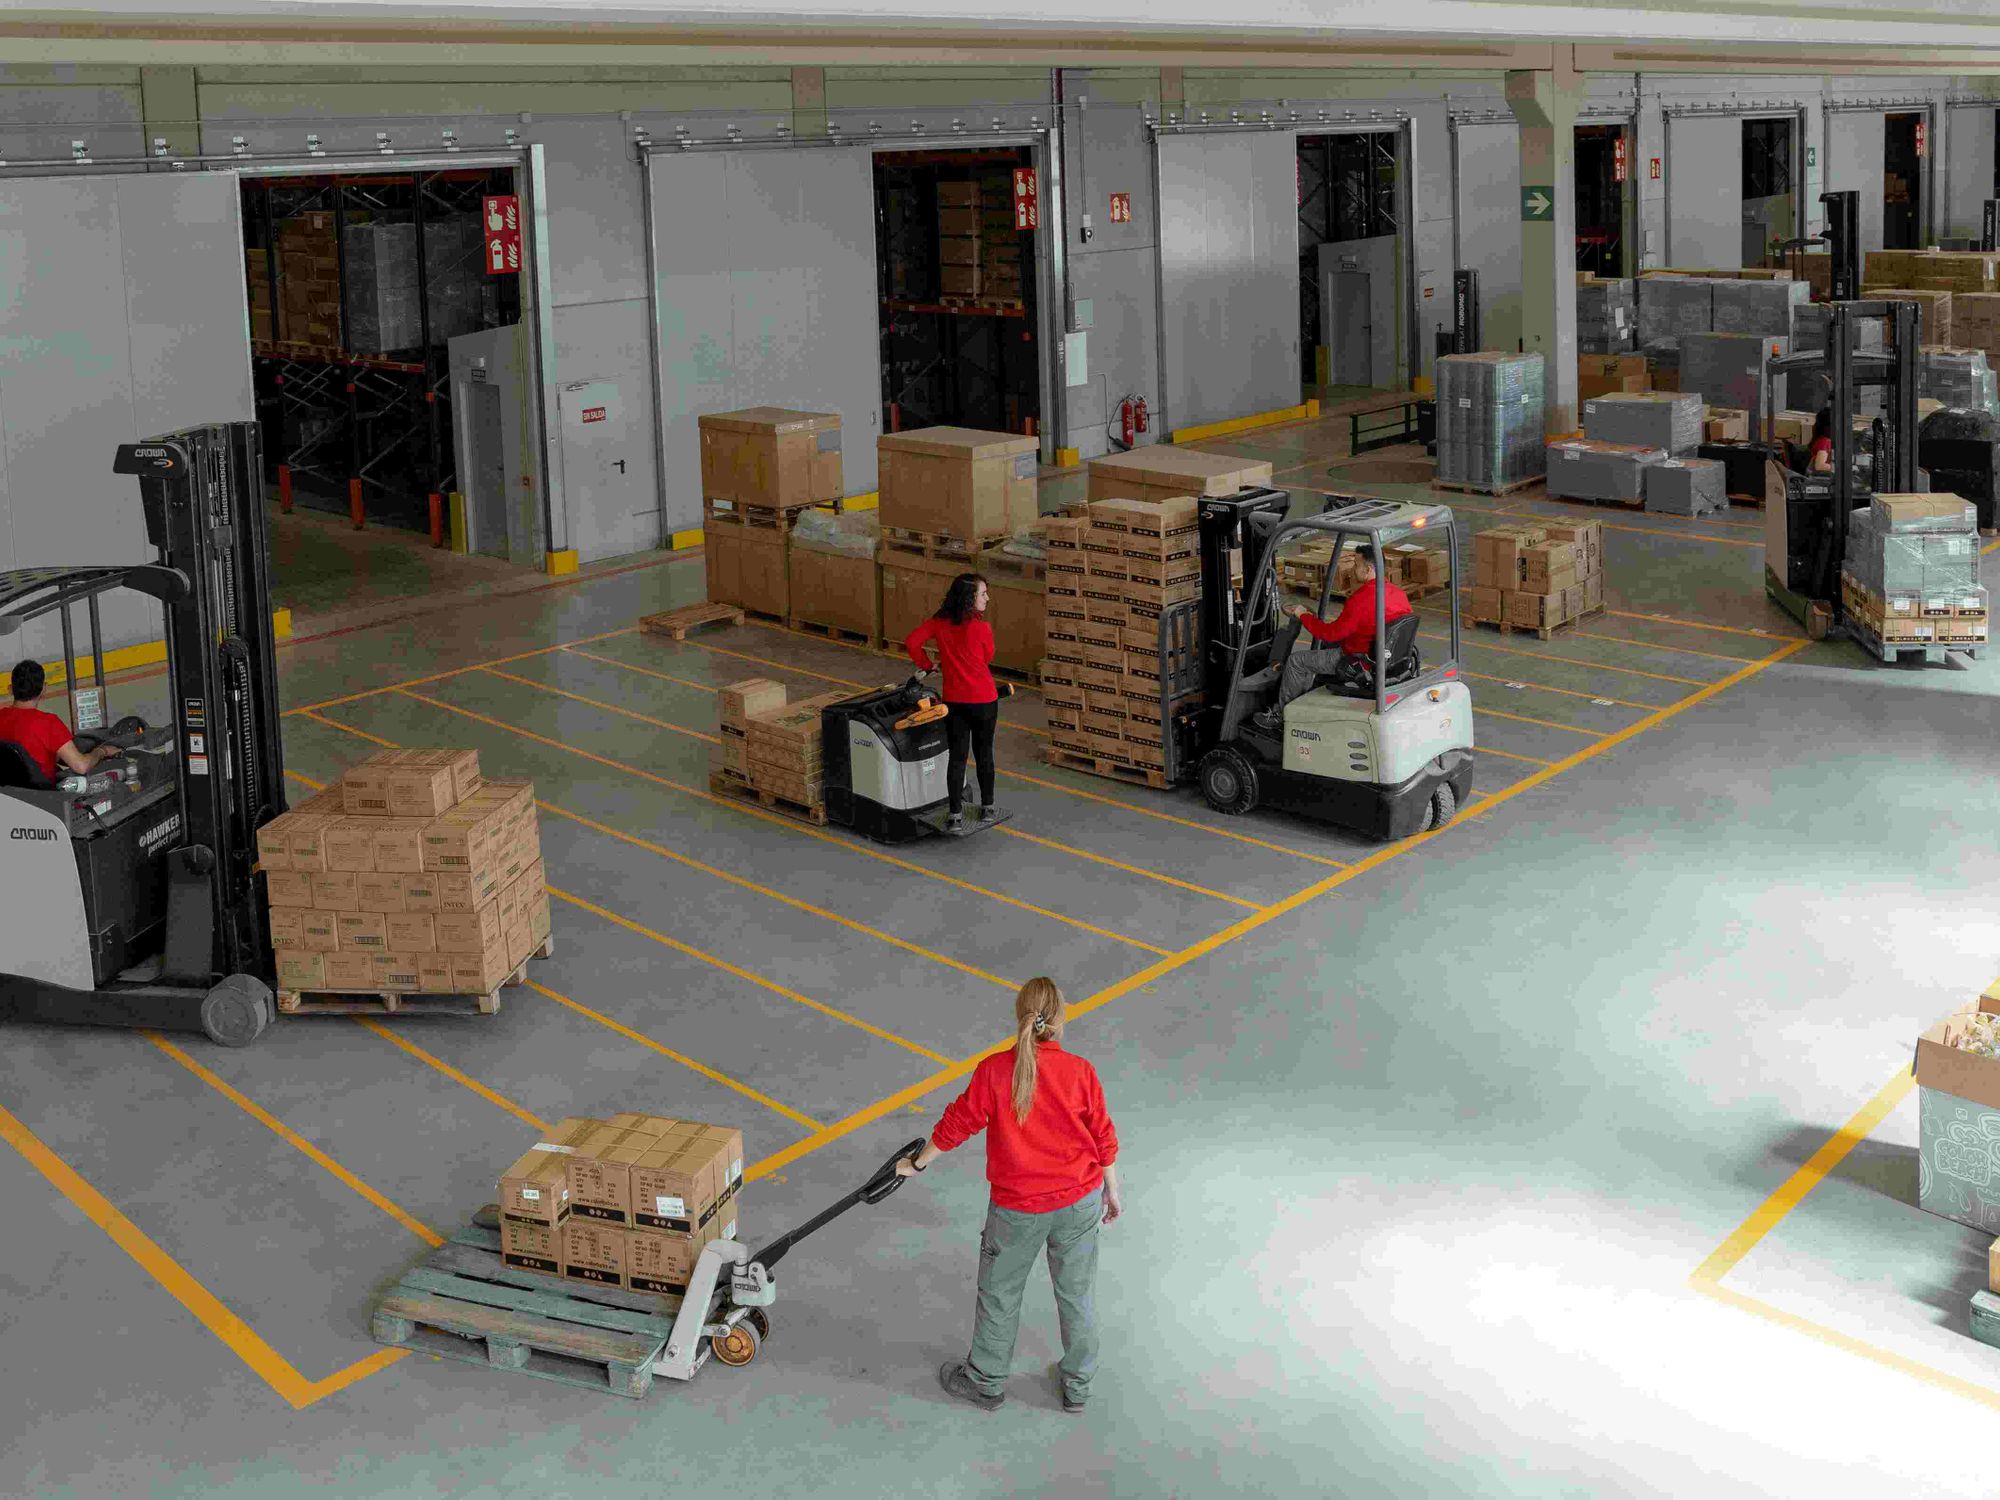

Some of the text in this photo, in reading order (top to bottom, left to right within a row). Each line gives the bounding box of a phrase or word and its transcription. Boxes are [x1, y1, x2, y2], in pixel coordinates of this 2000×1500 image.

[135, 448, 167, 457] CROWN
[1206, 503, 1230, 513] CROWN
[1291, 728, 1321, 742] CROWN
[10, 828, 58, 841] CROWN
[146, 814, 180, 845] HAWKER
